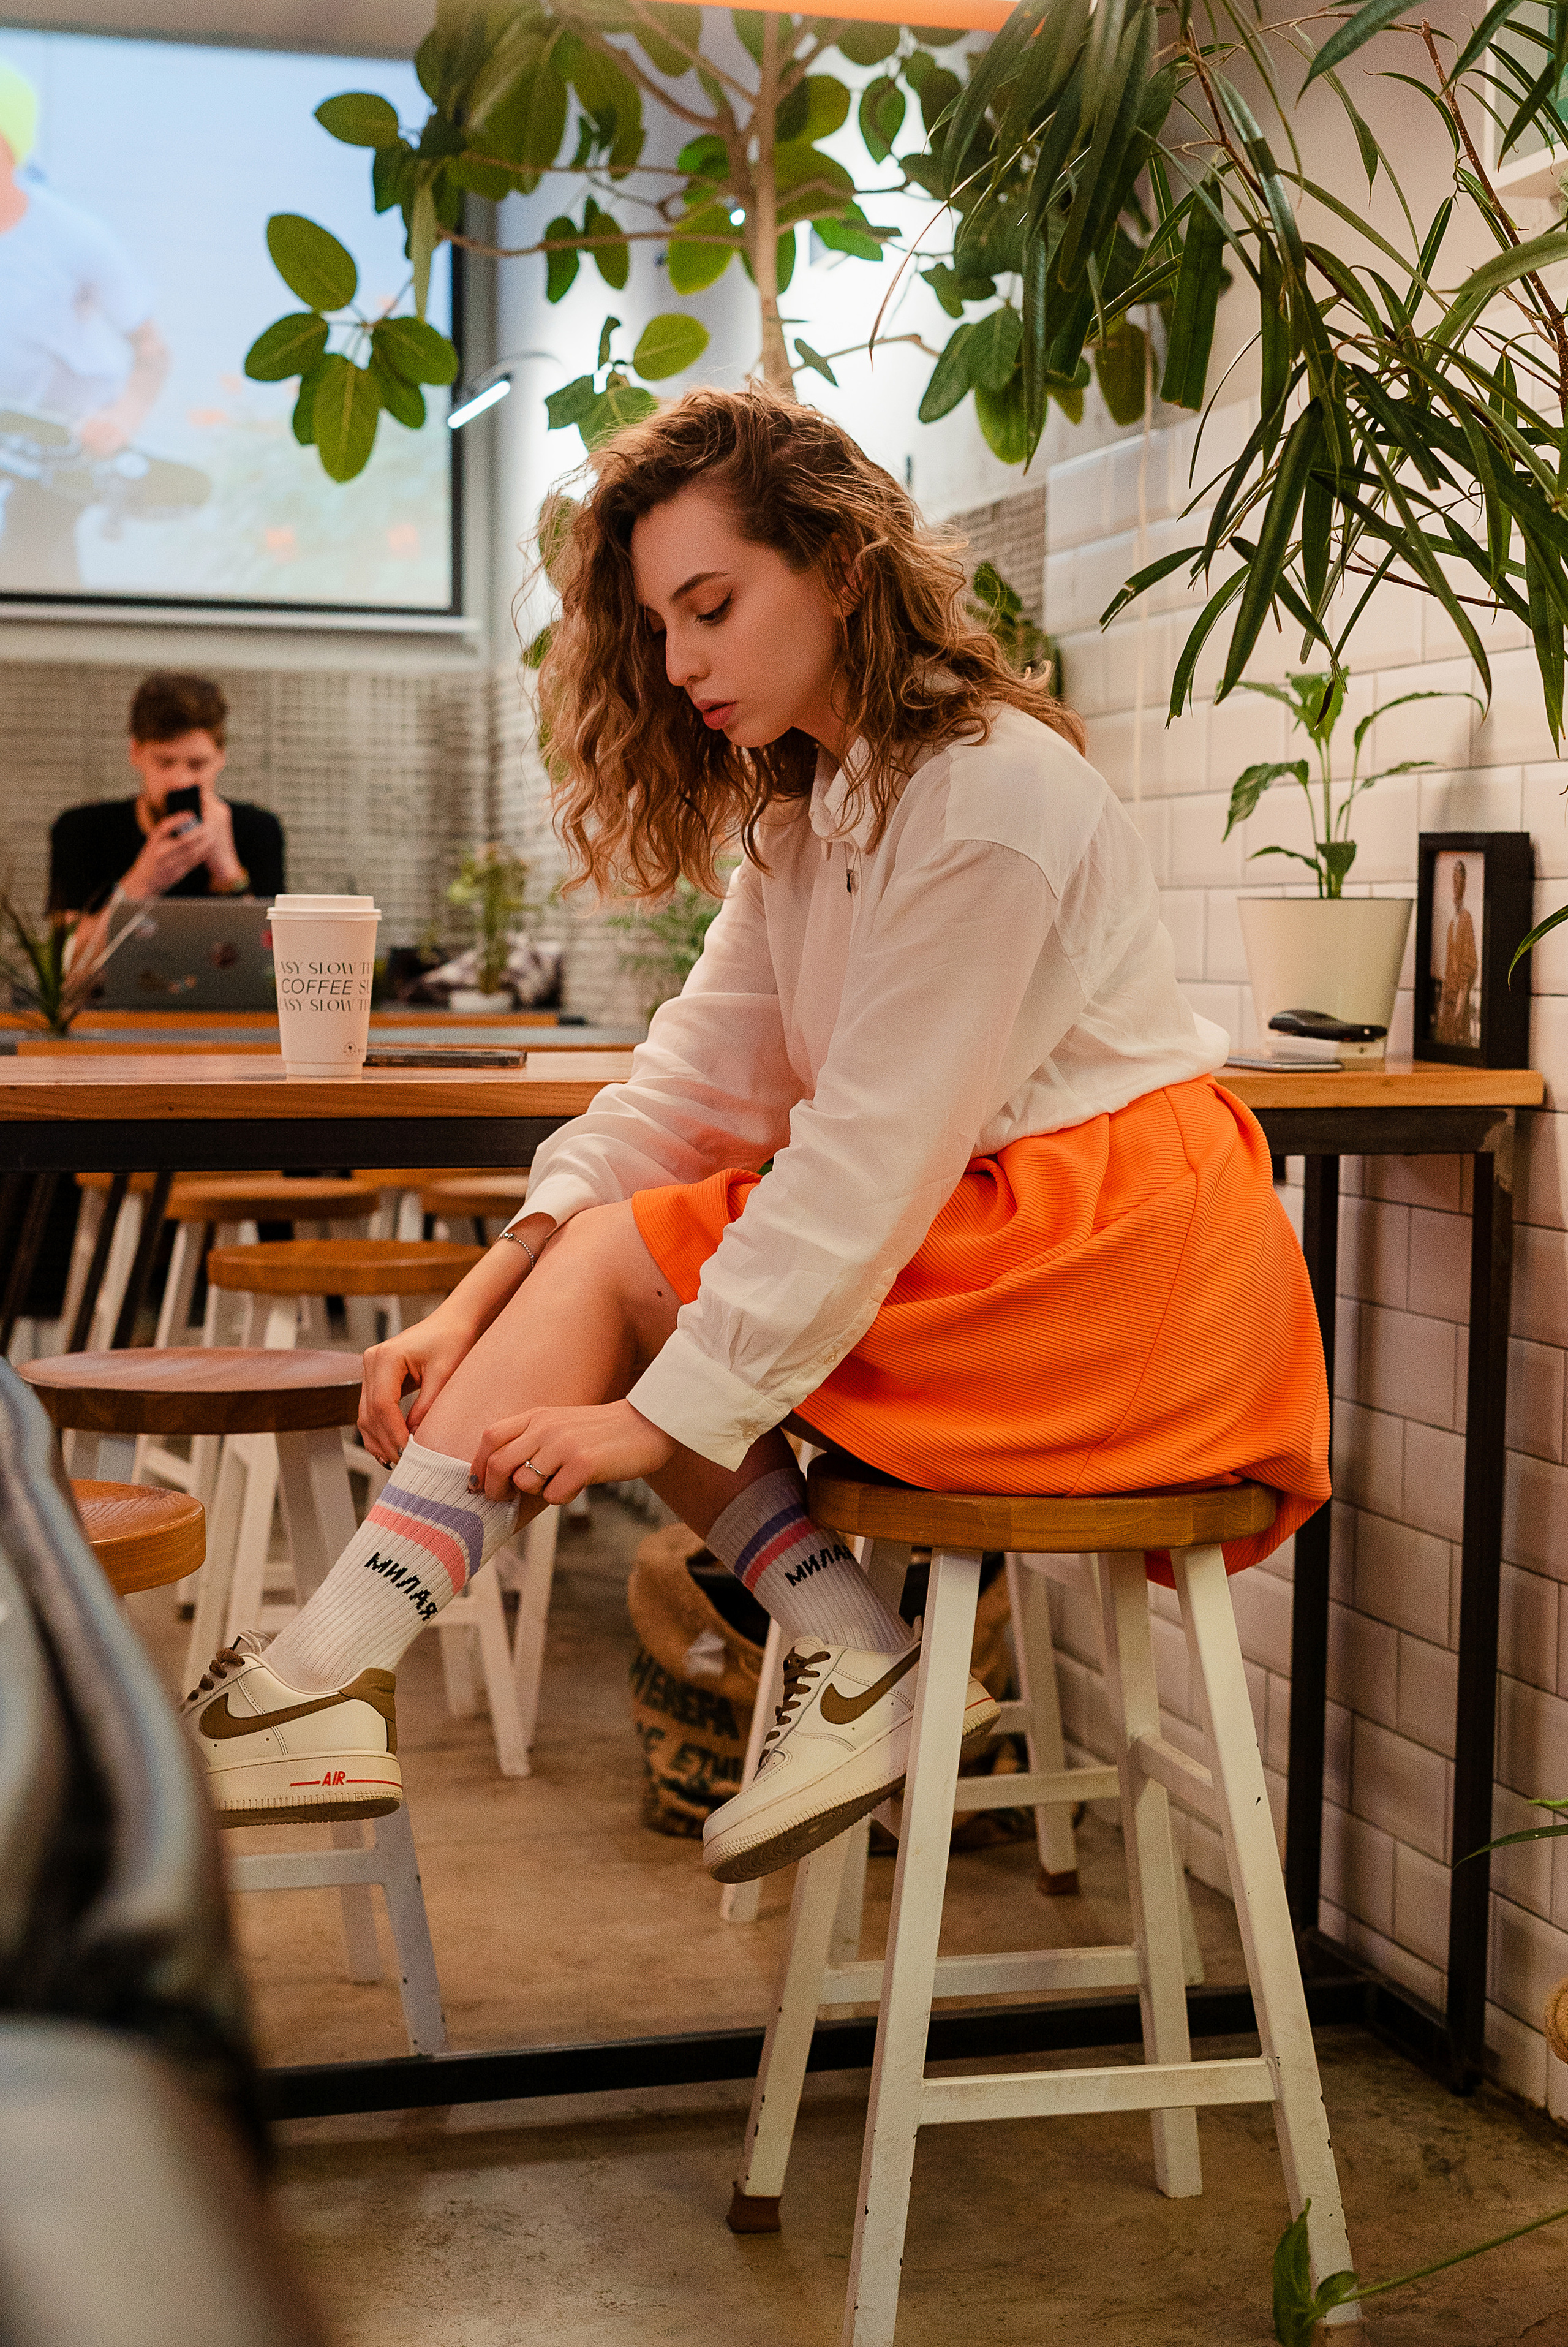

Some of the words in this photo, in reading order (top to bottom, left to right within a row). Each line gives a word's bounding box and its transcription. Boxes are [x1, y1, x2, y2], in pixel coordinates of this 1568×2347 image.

[309, 962, 356, 975] SLOW
[282, 978, 353, 995] COFFEE
[310, 999, 355, 1011] SLOW
[364, 1552, 439, 1621] МИЛАЯ
[322, 1771, 347, 1786] AIR
